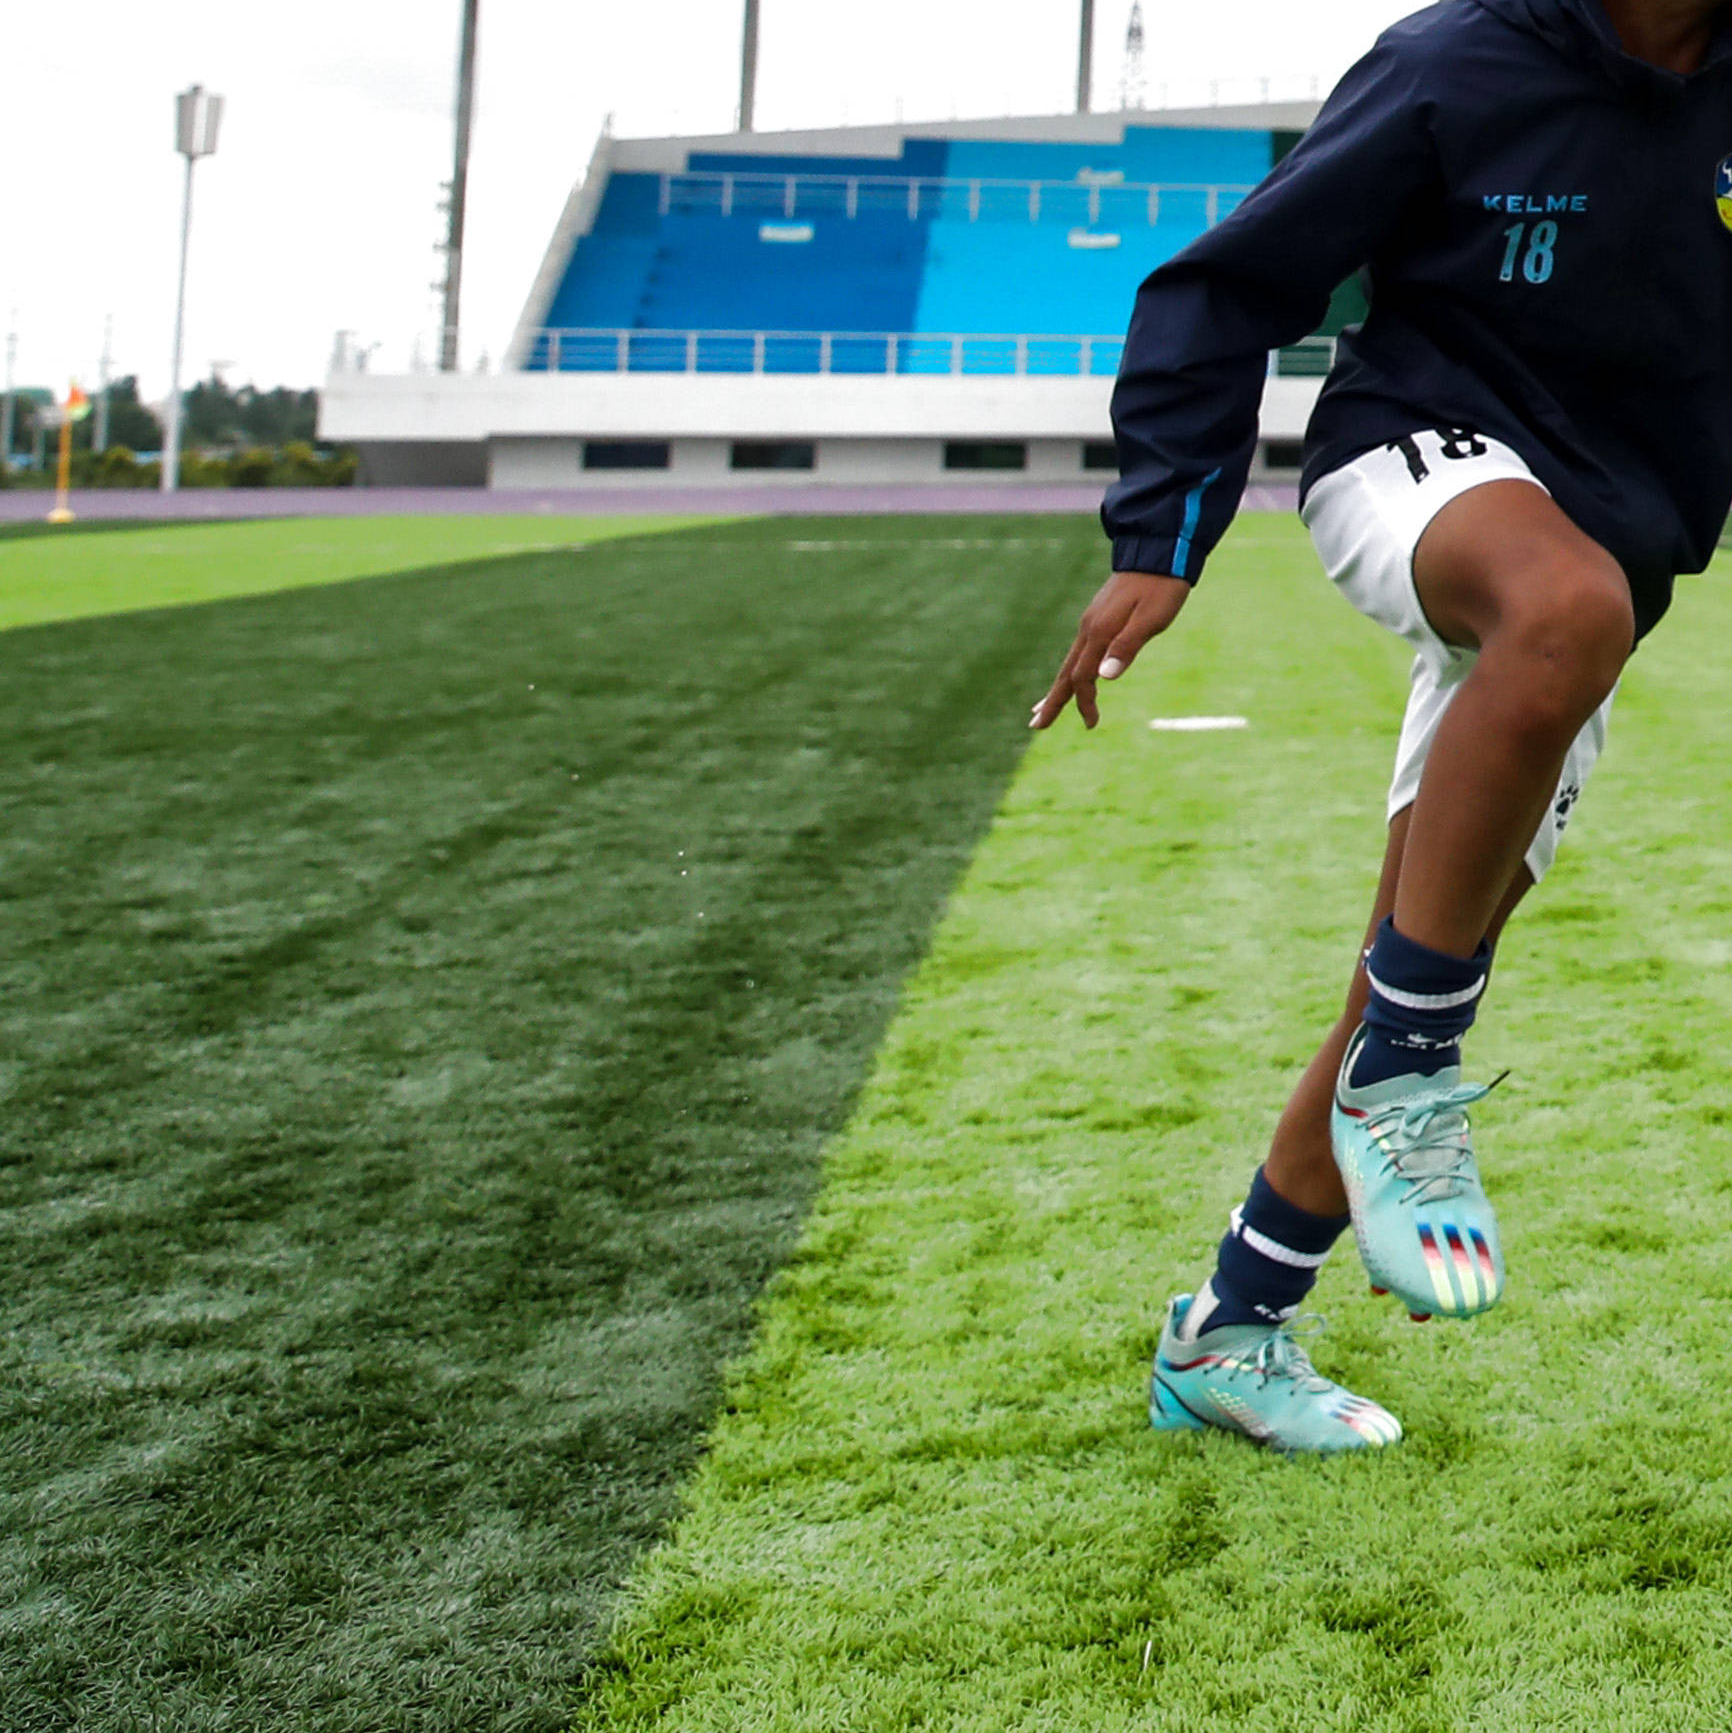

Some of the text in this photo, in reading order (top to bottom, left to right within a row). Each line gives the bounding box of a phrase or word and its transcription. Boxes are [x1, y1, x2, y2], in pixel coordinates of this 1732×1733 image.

[1483, 195, 1588, 213] KELME
[1499, 220, 1558, 284] 18
[1387, 428, 1488, 485] 18
